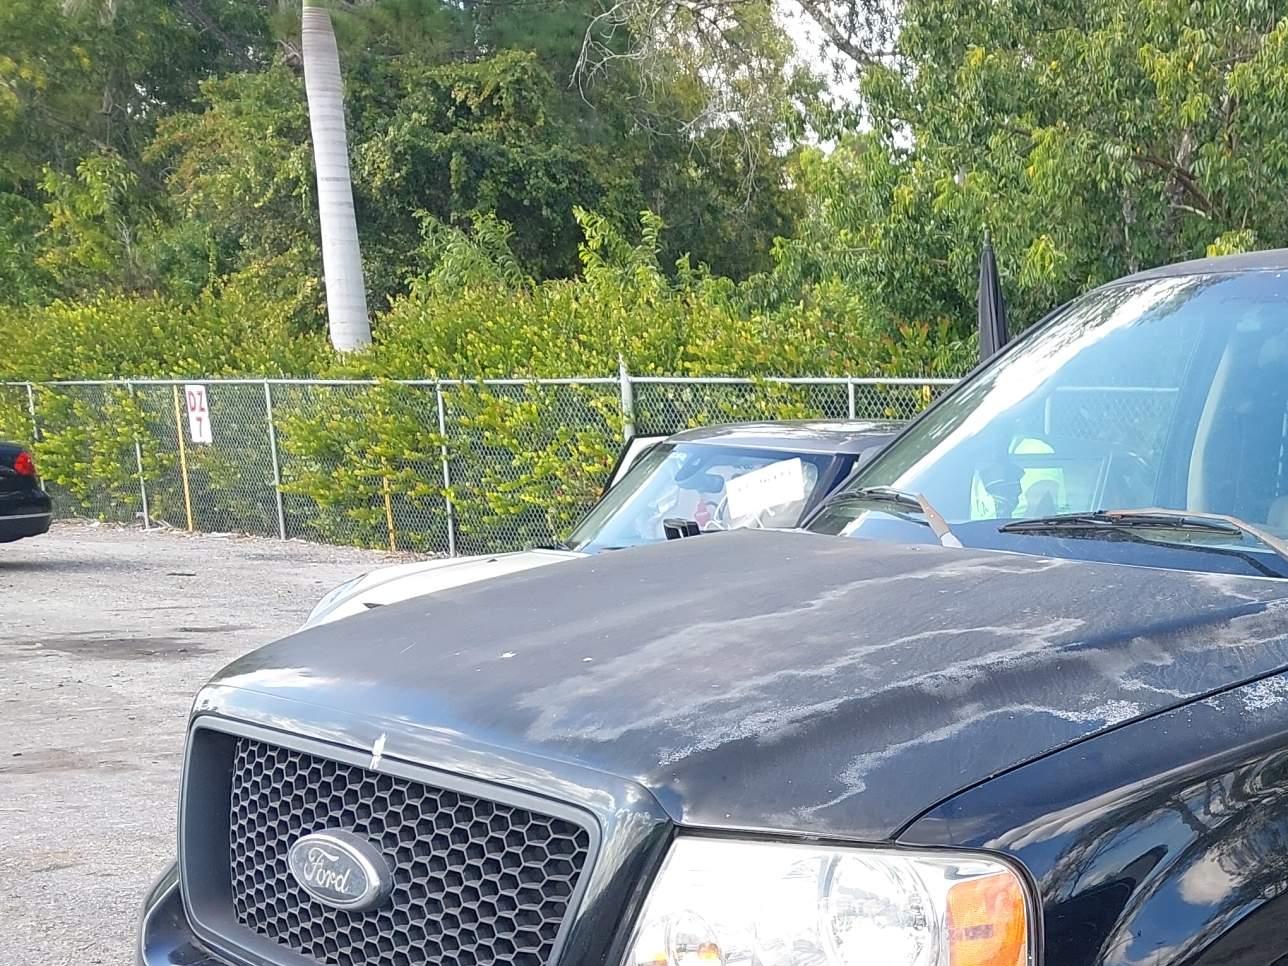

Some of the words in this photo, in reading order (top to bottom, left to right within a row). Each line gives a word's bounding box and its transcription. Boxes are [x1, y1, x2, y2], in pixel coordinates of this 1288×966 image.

[187, 390, 206, 413] DZ
[195, 416, 203, 438] 7
[303, 847, 351, 894] Ford
